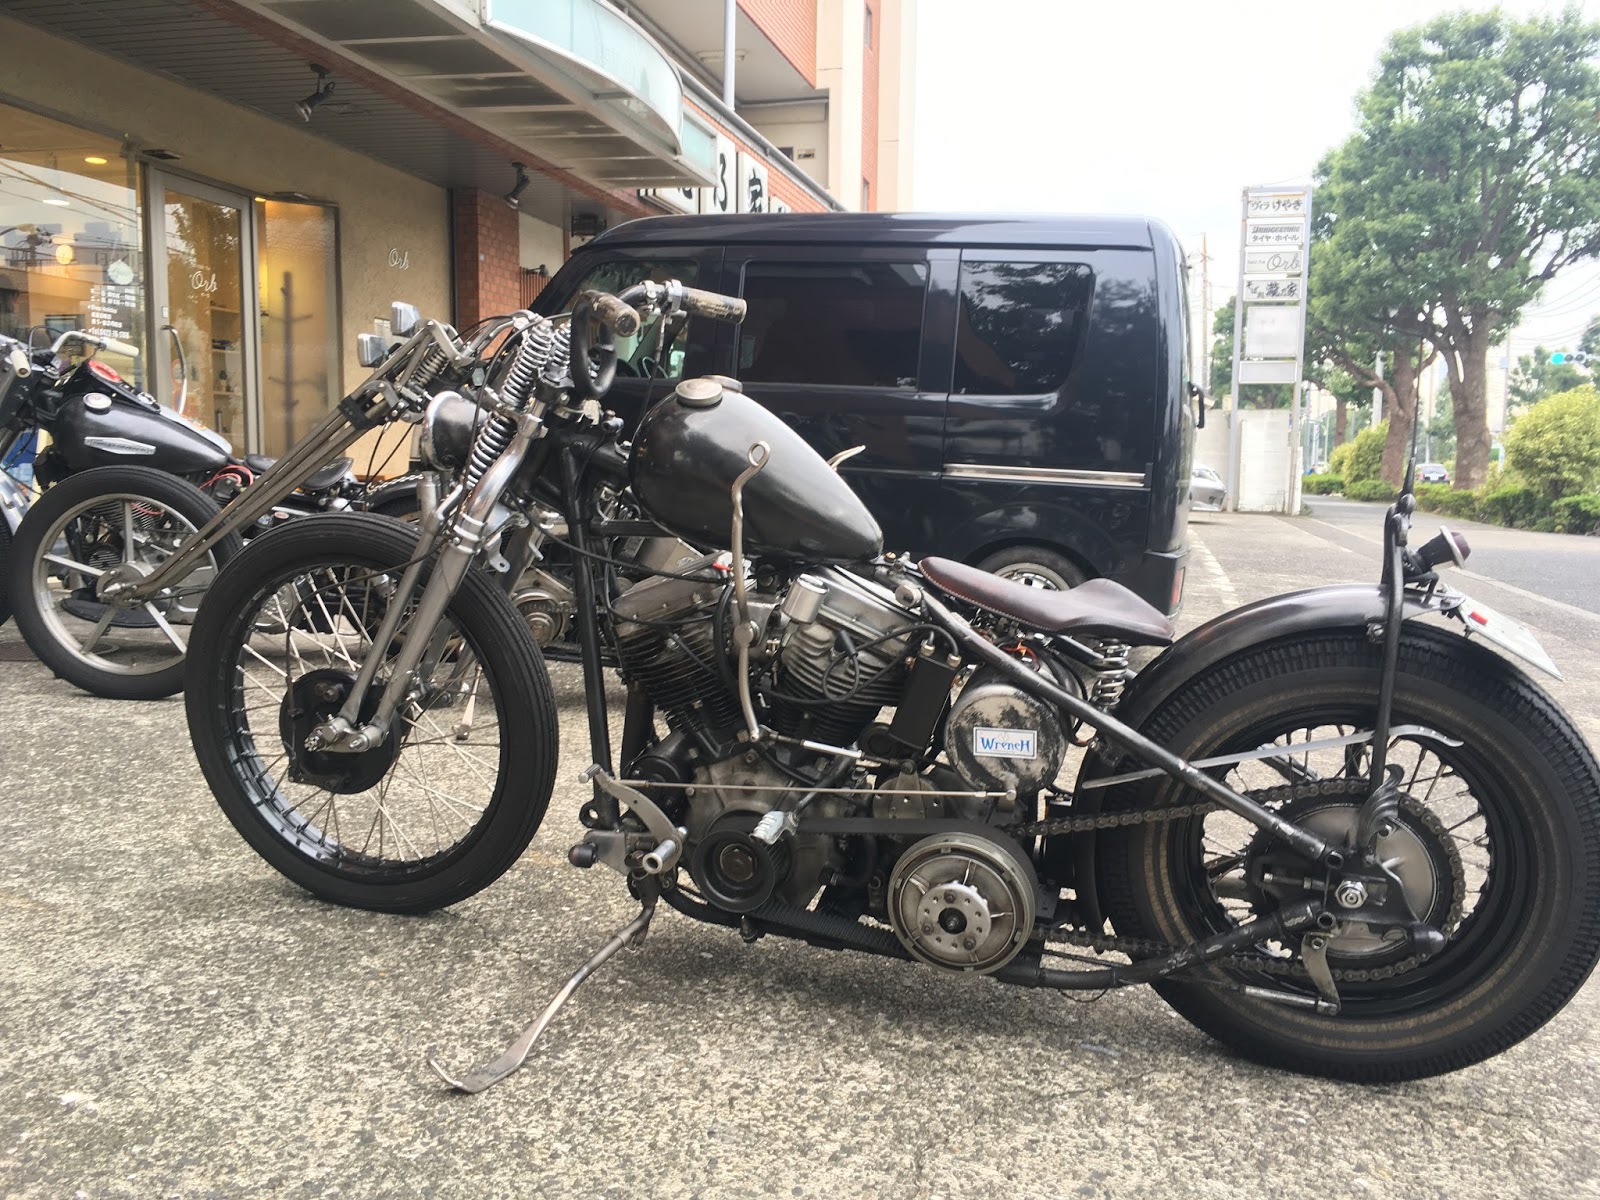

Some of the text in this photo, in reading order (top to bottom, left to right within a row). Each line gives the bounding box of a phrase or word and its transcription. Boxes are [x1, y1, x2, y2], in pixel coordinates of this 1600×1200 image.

[388, 247, 410, 270] Orb
[1267, 252, 1301, 271] Orb
[191, 270, 218, 292] Orb
